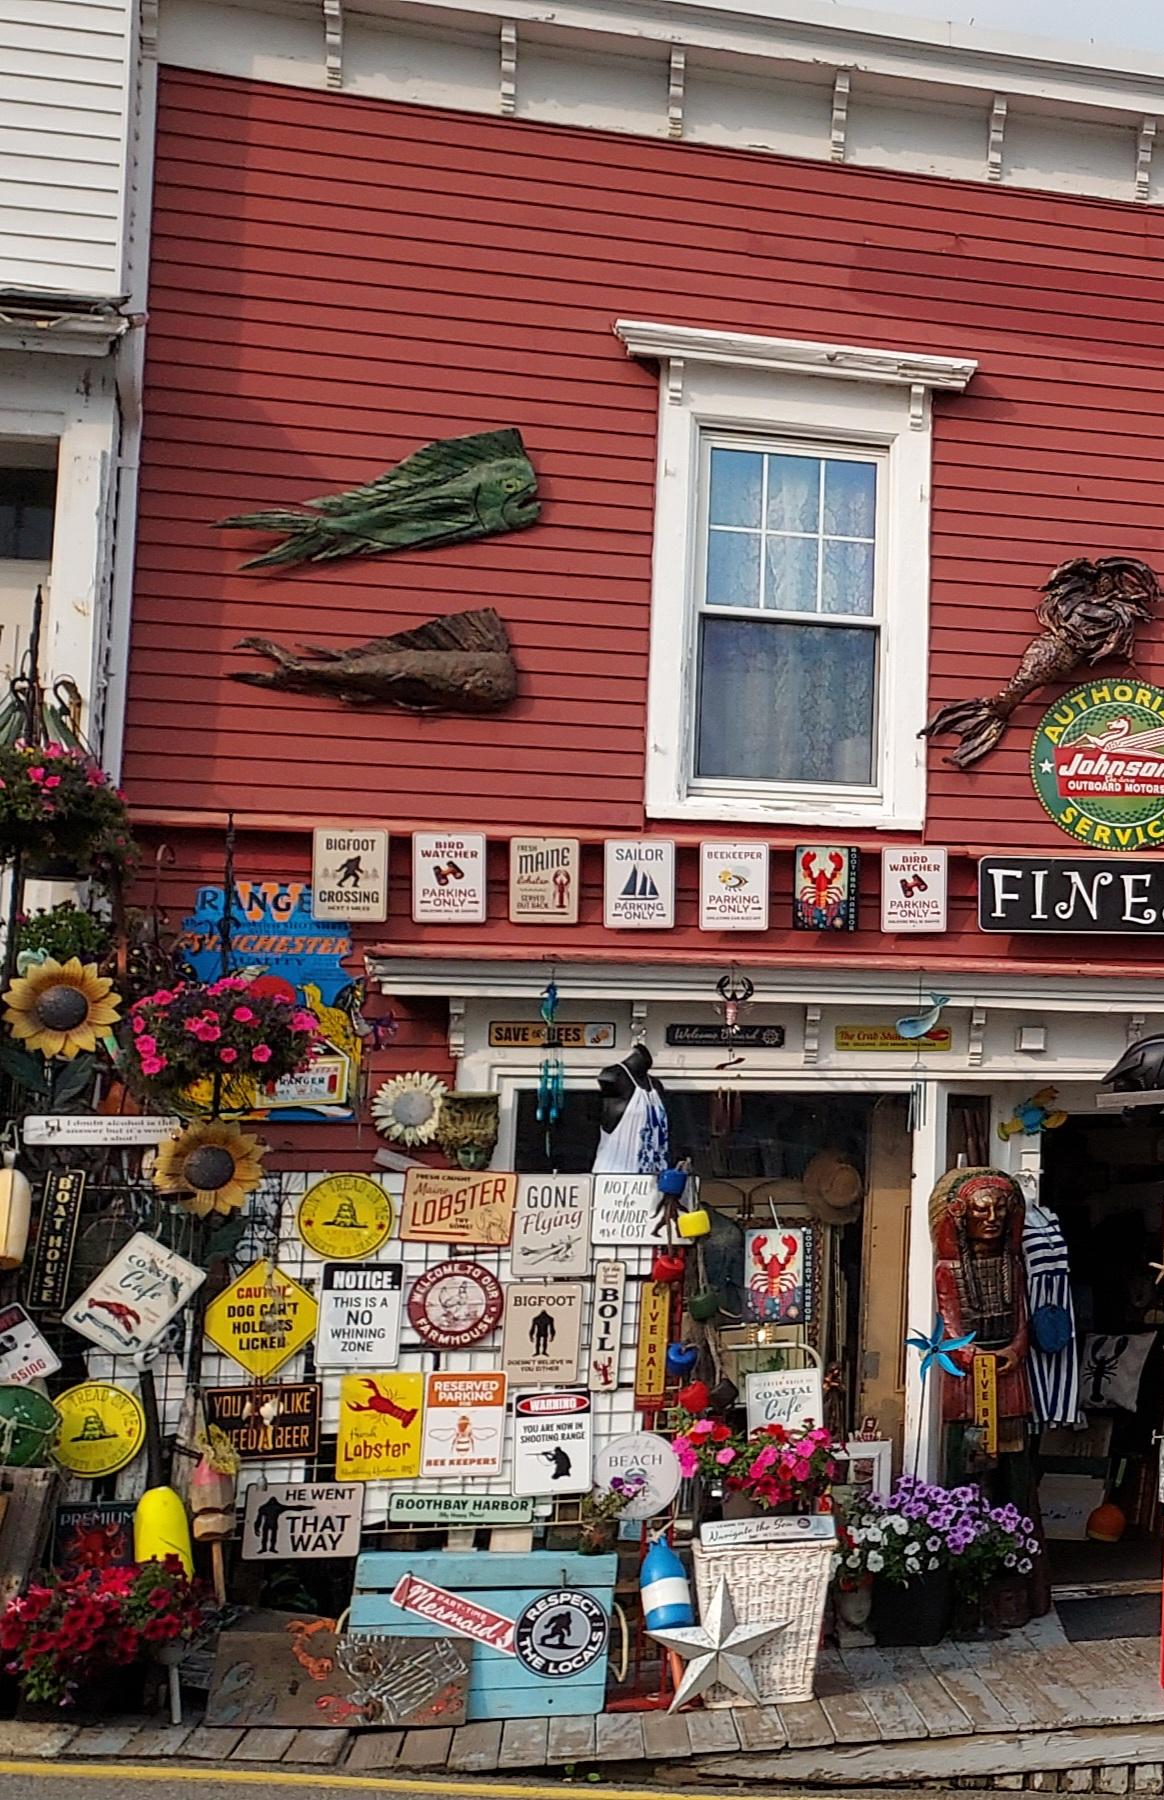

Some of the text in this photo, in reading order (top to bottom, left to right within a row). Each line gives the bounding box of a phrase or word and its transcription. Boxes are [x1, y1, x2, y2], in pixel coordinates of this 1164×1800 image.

[1068, 780, 1121, 792] OUTBOARD
[326, 838, 376, 853] BIGFOOT
[435, 840, 465, 850] BIRD
[421, 849, 478, 860] WATCHER
[519, 847, 570, 874] MAINE
[615, 848, 664, 861] SAILOR
[706, 851, 763, 861] BEEKEEPER
[901, 855, 929, 864] BIRD
[889, 863, 941, 872] WATCHER
[319, 889, 379, 904] CROSSING
[422, 888, 477, 899] PARKING
[708, 895, 760, 905] PARKING
[433, 897, 466, 908] ONLY
[614, 901, 665, 912] PARKING
[719, 904, 750, 914] ONLY
[889, 900, 939, 910] PARKING
[624, 910, 655, 921] ONLY
[899, 908, 928, 918] ONLY
[495, 1029, 529, 1042] SAVE
[603, 1180, 649, 1195] NOT ALL
[53, 1177, 73, 1231] BOAT
[411, 1178, 506, 1226] LOBSTER
[527, 1185, 579, 1208] GONE
[521, 1209, 583, 1235] Flying
[601, 1209, 649, 1224] WANDER
[620, 1224, 647, 1239] LOST
[41, 1235, 62, 1302] HOUSE
[411, 1263, 500, 1303] WELCOME TO OUR
[333, 1297, 388, 1308] THIS IS A
[513, 1295, 576, 1307] BIGFOOT
[804, 1282, 812, 1321] HARBOR
[227, 1304, 255, 1318] DOG
[346, 1310, 373, 1326] NO
[597, 1287, 619, 1351] BOIL
[330, 1328, 386, 1340] WHINING
[416, 1314, 495, 1344] FARMHOUSE
[341, 1341, 373, 1352] ZONE
[646, 1343, 657, 1393] BAIT
[434, 1380, 500, 1392] RESERVED
[981, 1358, 989, 1401] LIVE
[437, 1390, 494, 1402] PARKING
[755, 1386, 813, 1401] COASTAL
[214, 1396, 241, 1418] YOU
[284, 1391, 311, 1414] LIKE
[529, 1398, 577, 1411] WARNING
[523, 1421, 584, 1433] YOU ARE NOW IN
[275, 1425, 309, 1448] BEER
[520, 1430, 586, 1444] SHOOTING RANGE
[343, 1438, 412, 1462] Lobster
[426, 1457, 498, 1467] BEE KEEPERS
[608, 1453, 663, 1468] BEACH
[285, 1487, 357, 1501] HE WENT
[395, 1498, 529, 1511] BOOTHBAY HARBOR
[60, 1510, 136, 1527] PREMIUM
[286, 1514, 352, 1534] THAT
[709, 1526, 753, 1542] Navigate
[755, 1521, 771, 1534] the
[290, 1533, 343, 1552] WAY
[407, 1584, 501, 1640] Mermaid
[526, 1592, 601, 1622] RESPECT
[519, 1630, 603, 1674] THE LOCALS
